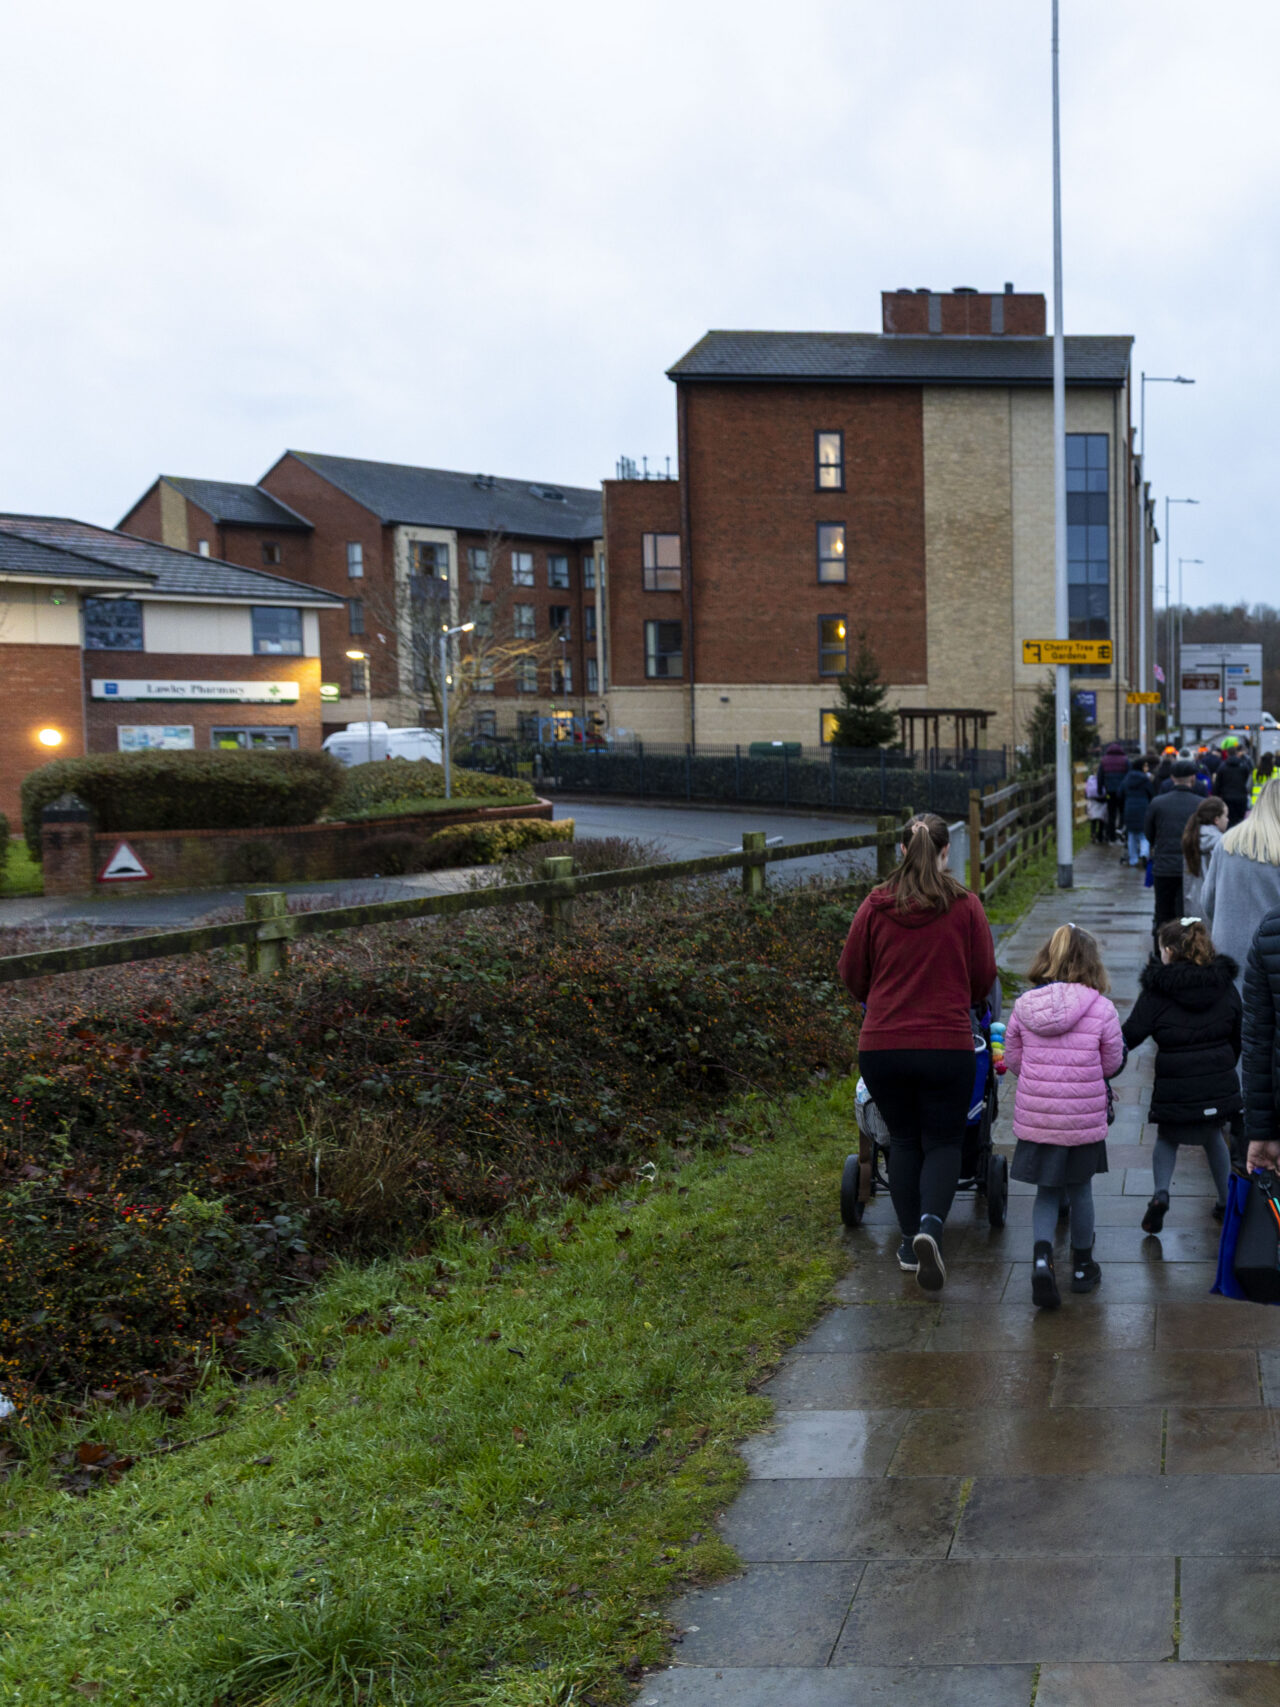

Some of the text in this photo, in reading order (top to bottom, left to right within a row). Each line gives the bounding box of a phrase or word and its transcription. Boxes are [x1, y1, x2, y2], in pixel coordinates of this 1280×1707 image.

[1044, 643, 1094, 654] Cherry Tree
[1051, 652, 1087, 660] Gardens
[190, 685, 245, 696] Pharmacy
